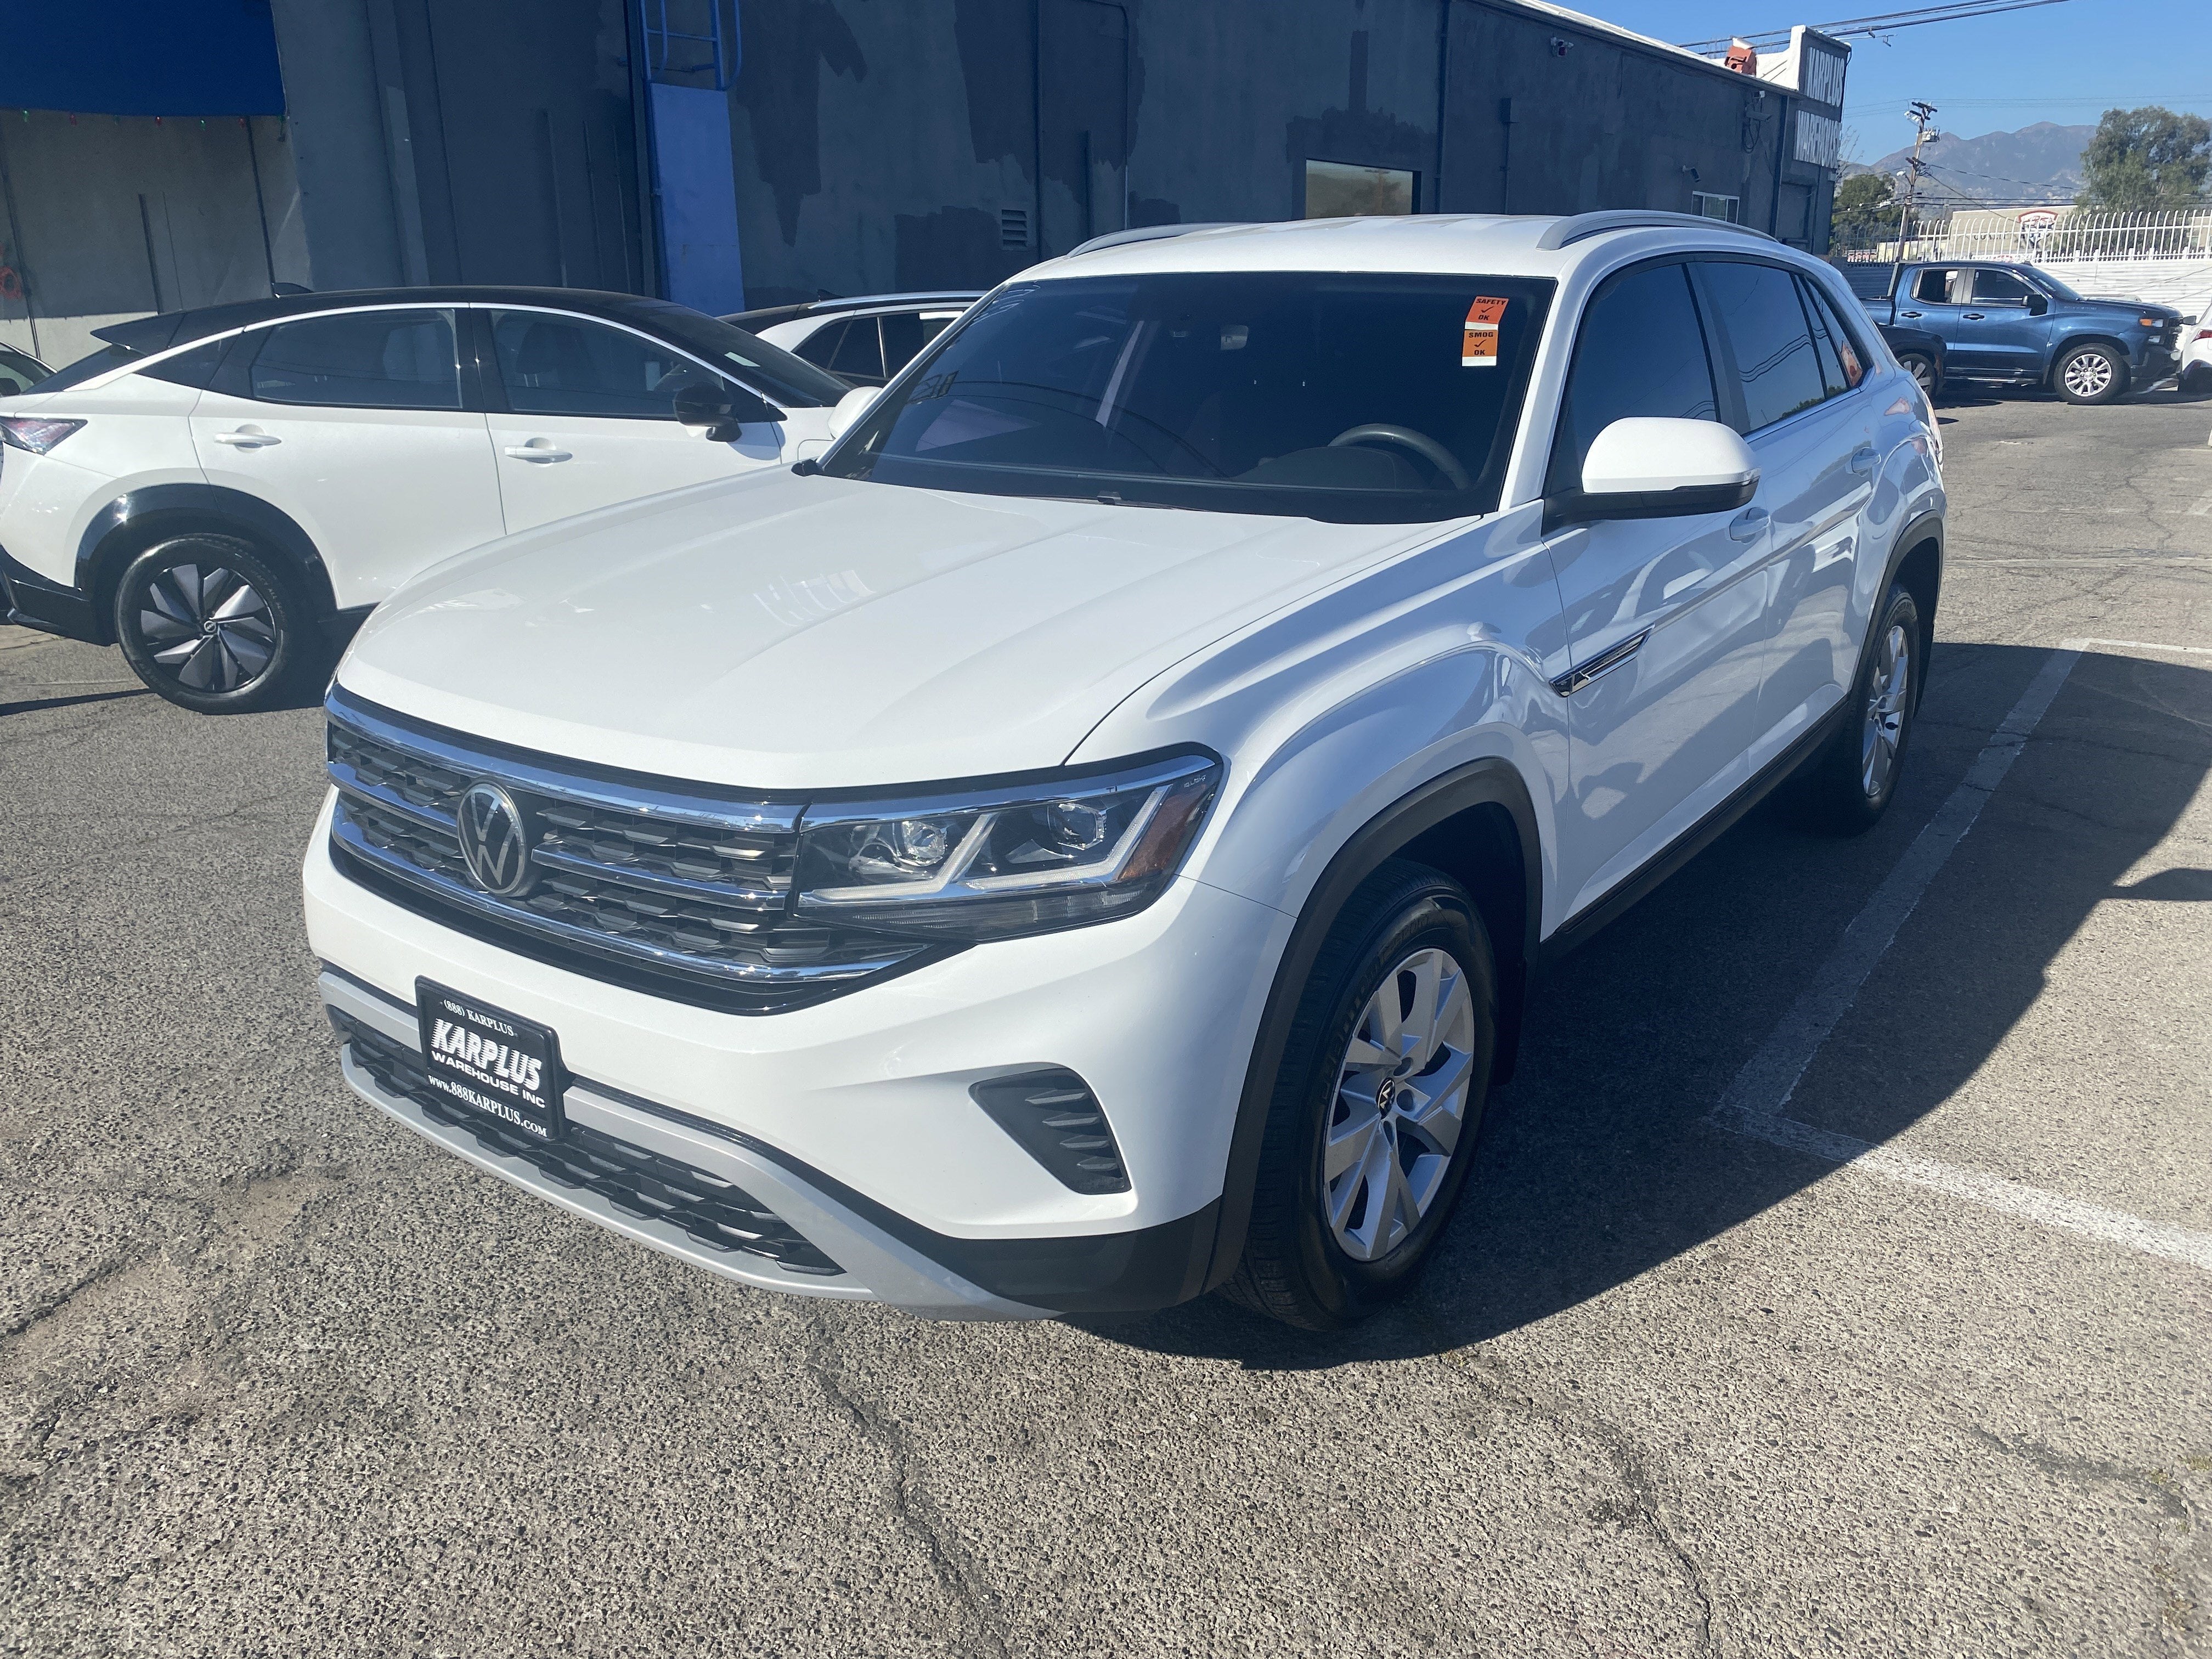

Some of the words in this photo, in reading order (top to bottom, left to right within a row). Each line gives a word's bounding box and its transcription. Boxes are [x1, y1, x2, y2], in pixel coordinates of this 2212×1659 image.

[1805, 47, 1845, 108] KARPLUS
[443, 998, 465, 1017] (888)
[466, 1009, 514, 1037] KARPLUS
[431, 1018, 543, 1091] KARPLUS
[431, 1050, 520, 1096] WAREHOUSE
[522, 1090, 545, 1108] INC
